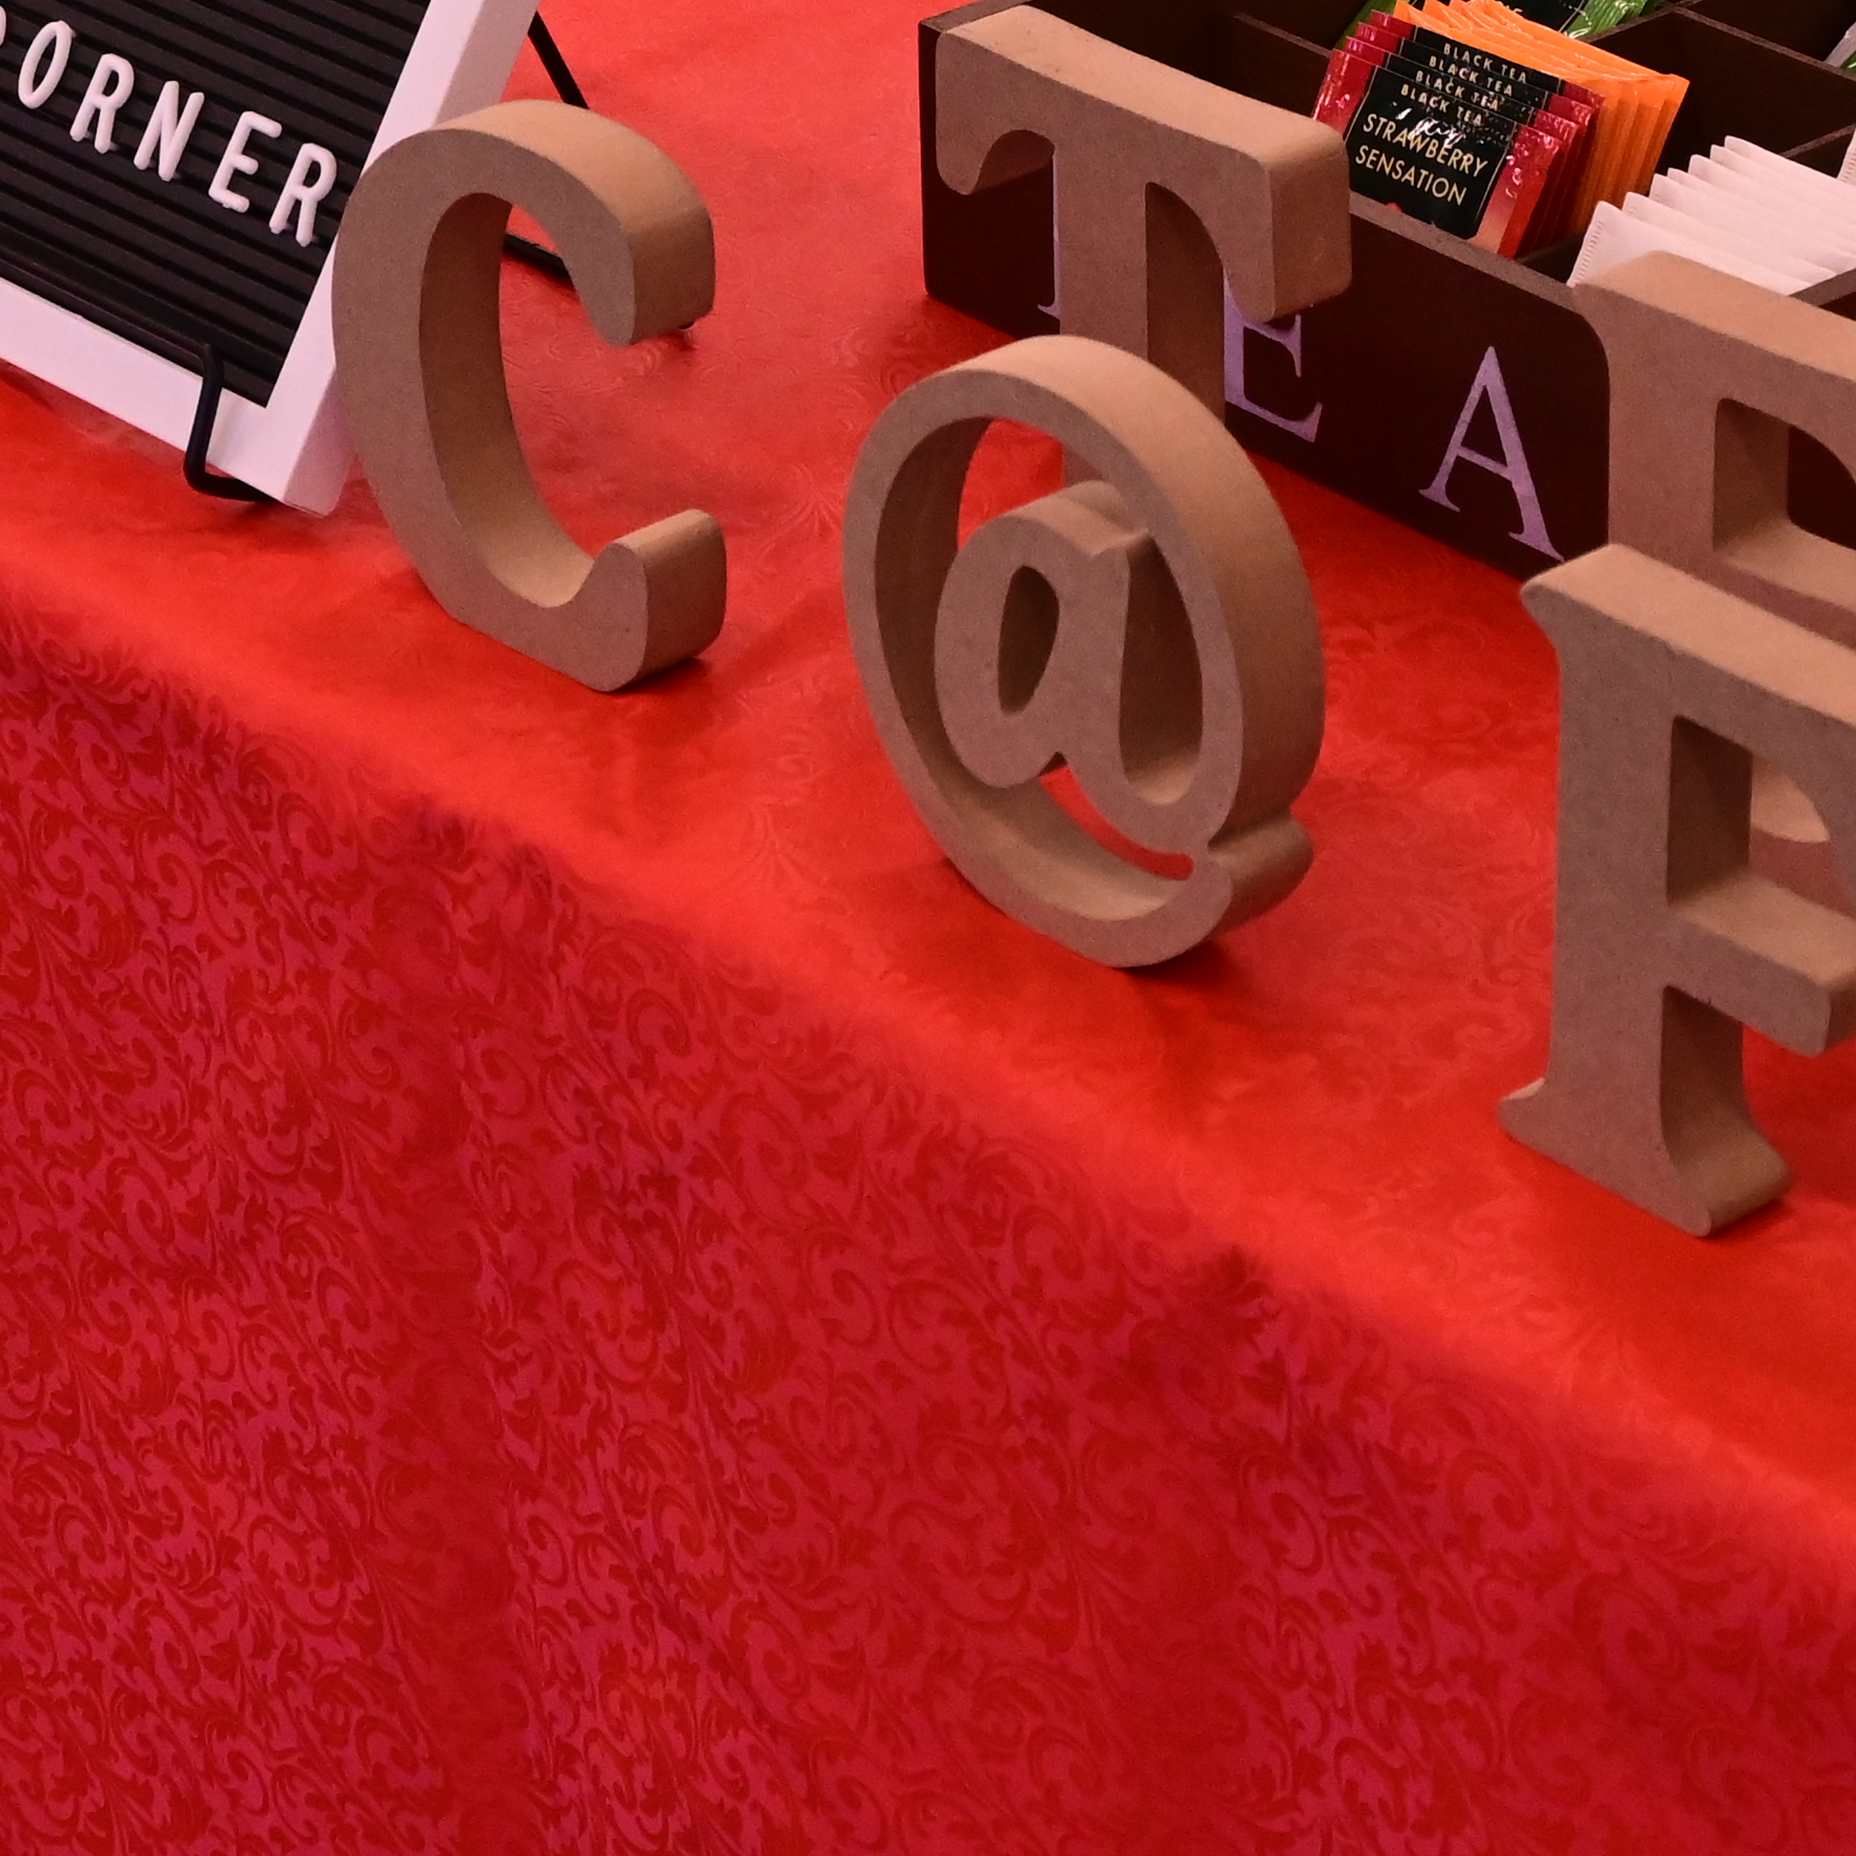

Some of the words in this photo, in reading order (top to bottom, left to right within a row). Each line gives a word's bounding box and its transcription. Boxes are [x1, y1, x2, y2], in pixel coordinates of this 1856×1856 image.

[1429, 56, 1478, 84] BLACK
[1486, 76, 1512, 95] TEA
[1443, 43, 1492, 71] BLACK
[1501, 65, 1527, 84] TEA
[1400, 84, 1449, 113] BLACK
[1456, 106, 1483, 125] TEA
[1416, 70, 1464, 98] BLACK
[1471, 90, 1499, 110] TEA
[1363, 113, 1488, 178] STRAWBERRY
[1355, 144, 1467, 206] SENSATION
